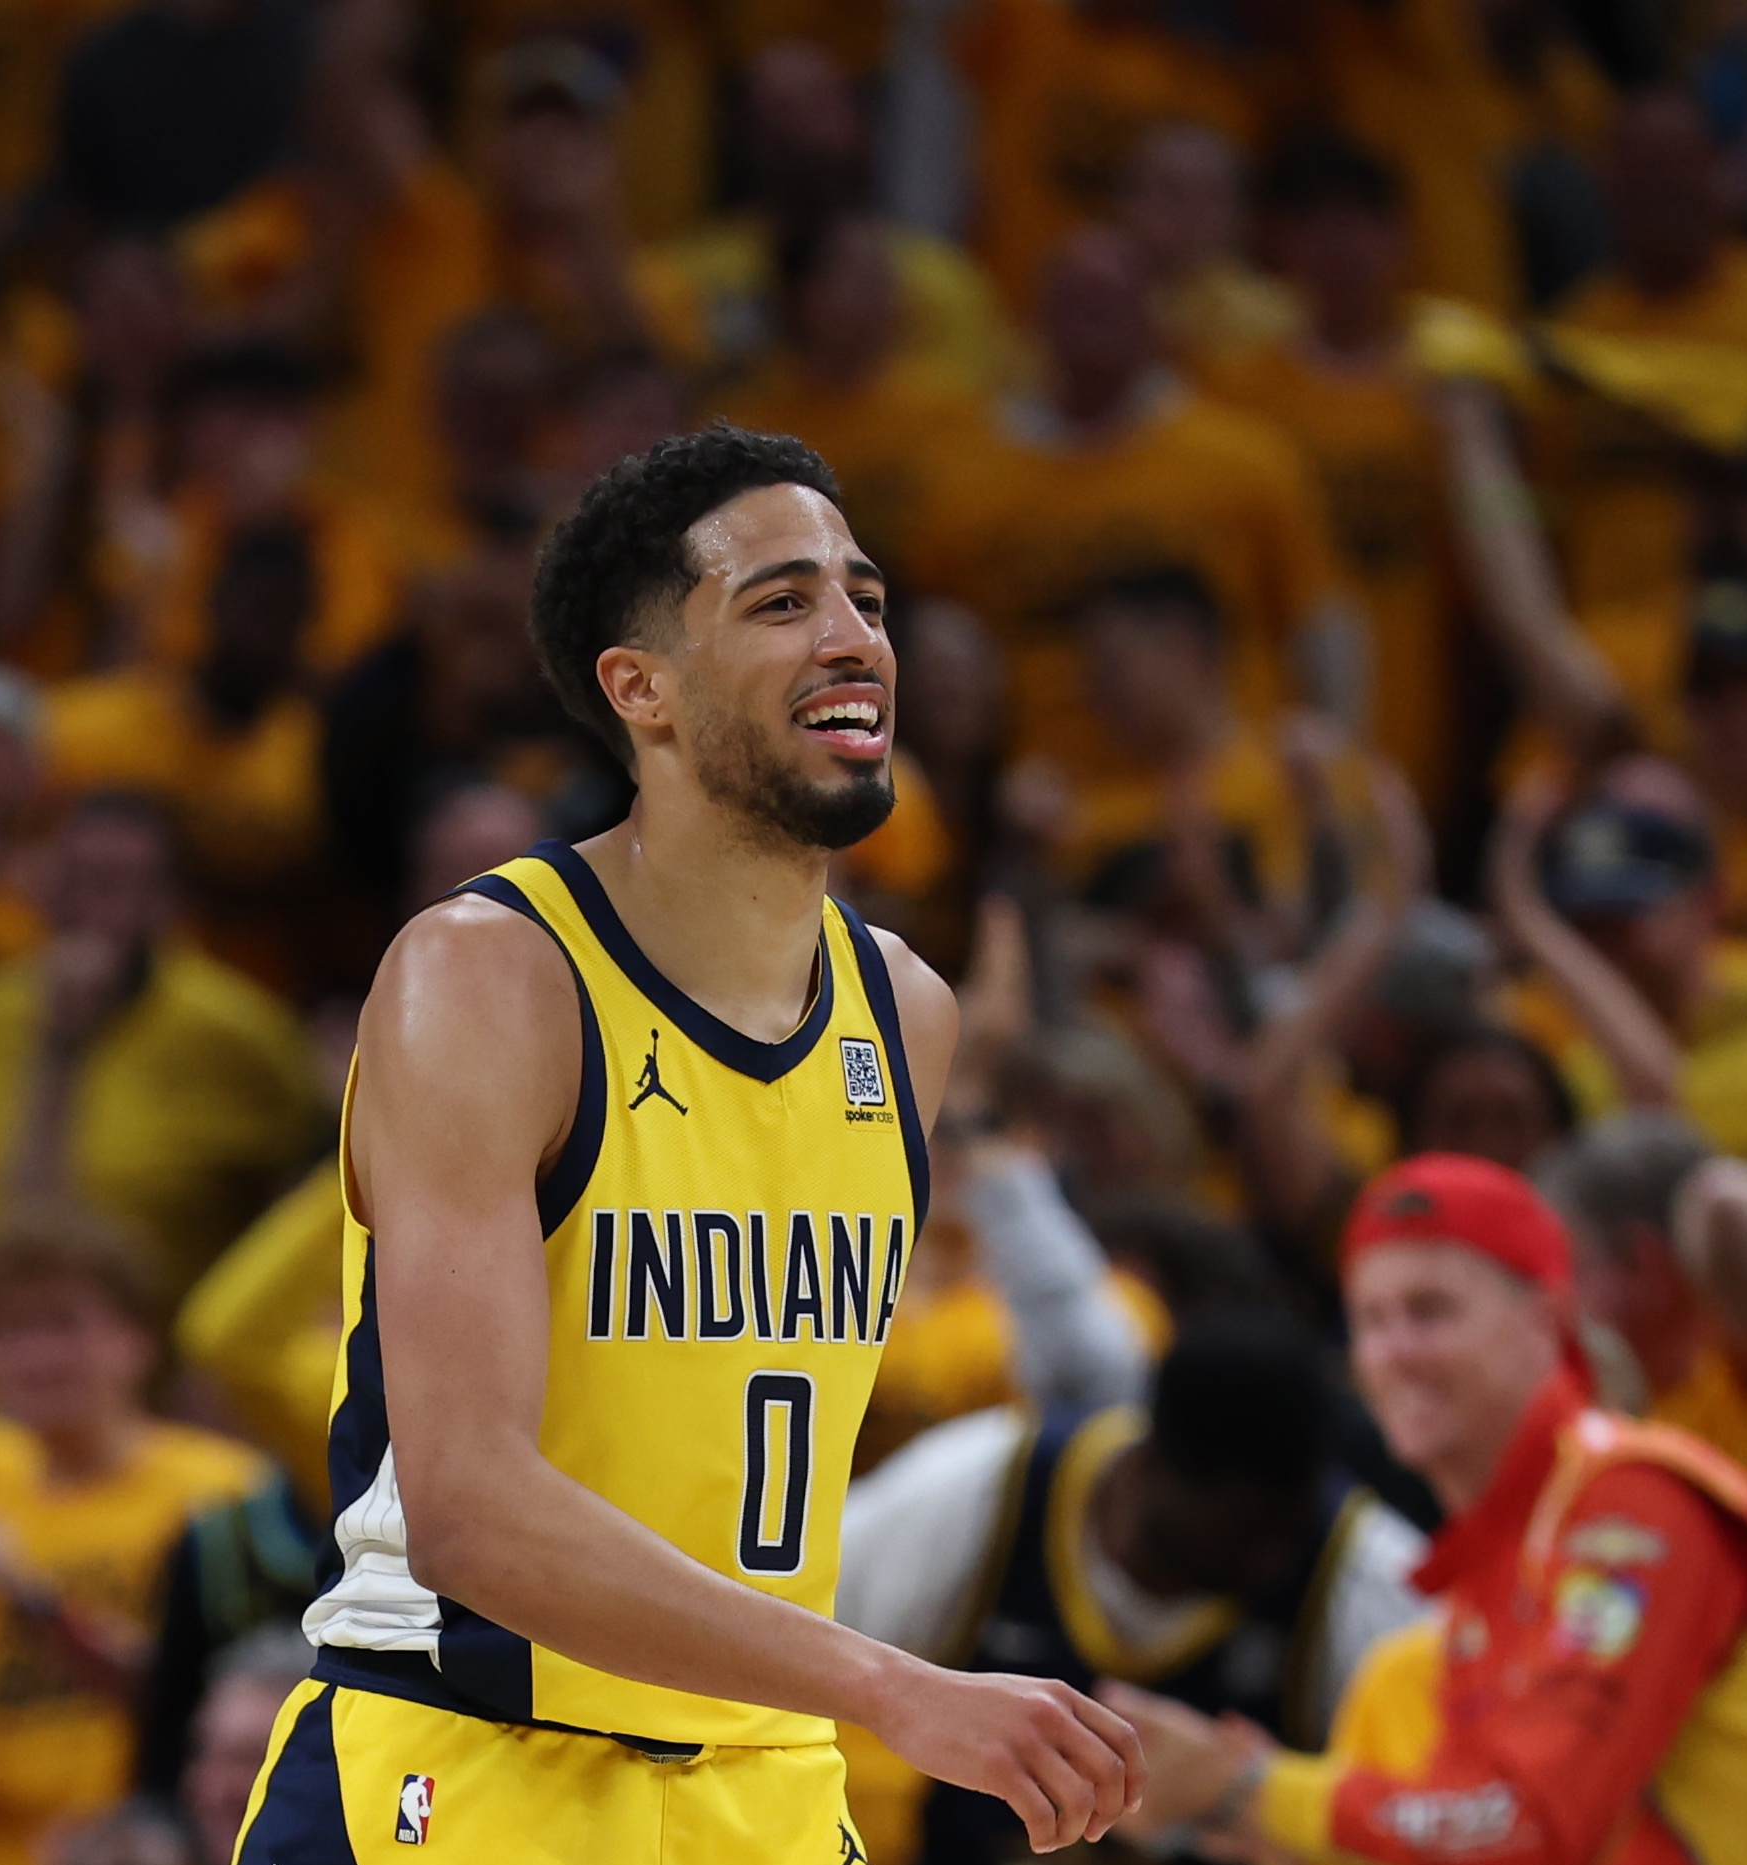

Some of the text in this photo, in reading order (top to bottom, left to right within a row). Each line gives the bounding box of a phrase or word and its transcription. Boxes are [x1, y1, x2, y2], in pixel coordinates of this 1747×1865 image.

[845, 1107, 894, 1125] spokenote
[586, 1208, 906, 1346] INDIANA
[735, 1368, 817, 1578] 0
[397, 1828, 416, 1842] NBA
